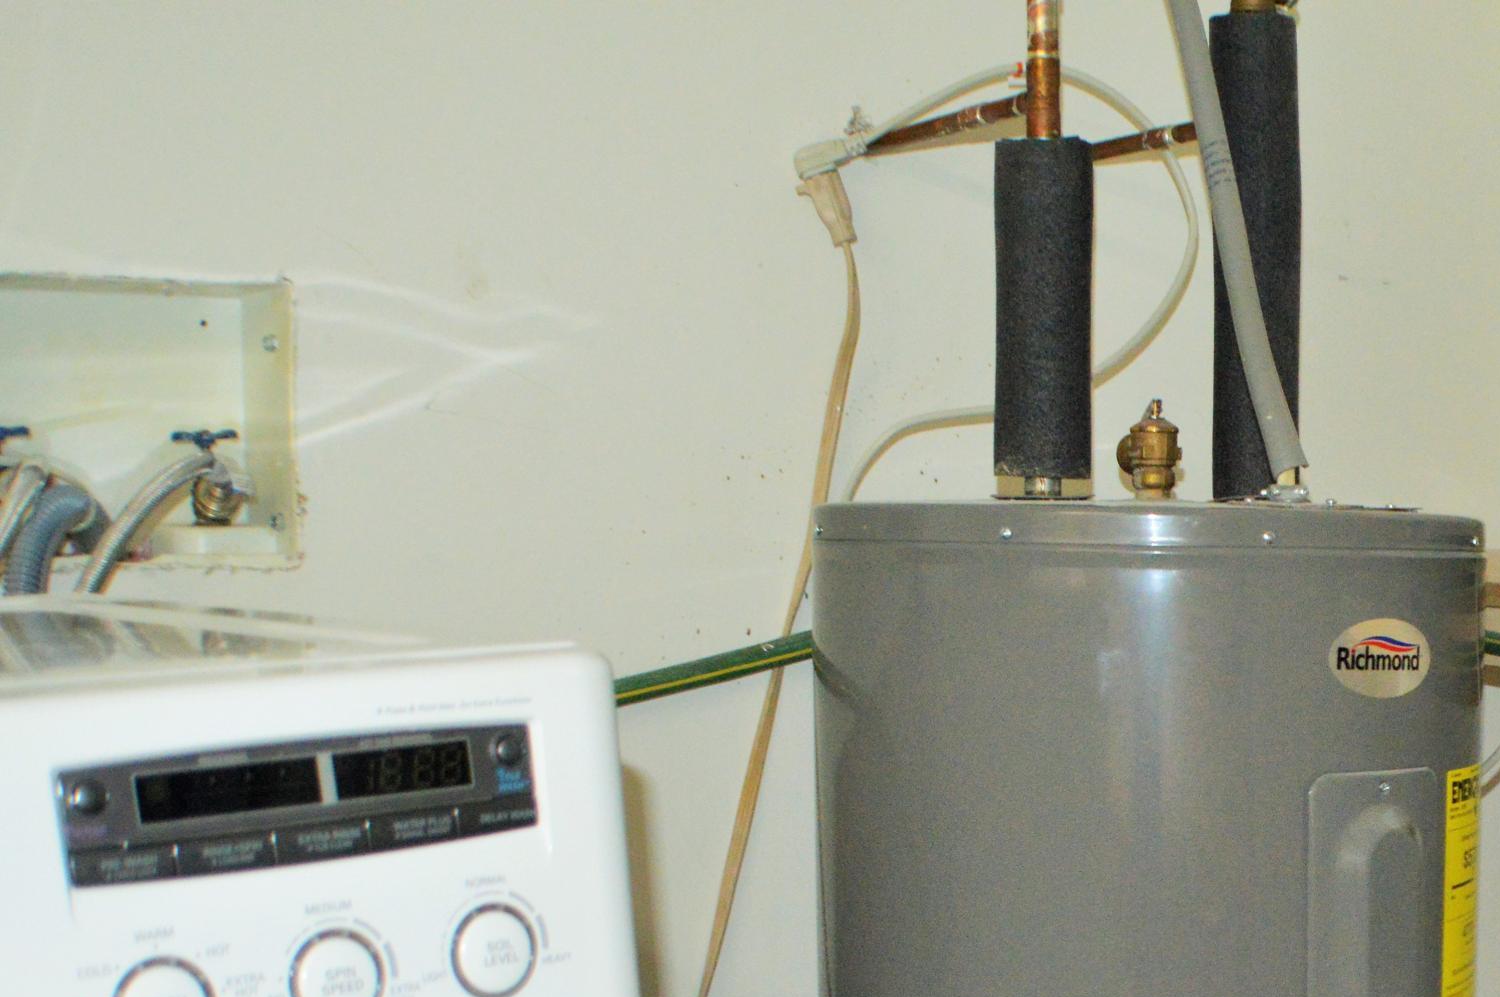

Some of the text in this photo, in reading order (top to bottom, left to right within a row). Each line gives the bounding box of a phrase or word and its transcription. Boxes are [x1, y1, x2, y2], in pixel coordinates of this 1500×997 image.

[1337, 646, 1420, 671] Richmond
[304, 899, 353, 915] MEDIUM
[134, 925, 175, 944] WARM
[483, 952, 520, 969] LEVEL
[324, 966, 358, 981] SPIN
[321, 979, 365, 997] SPEED
